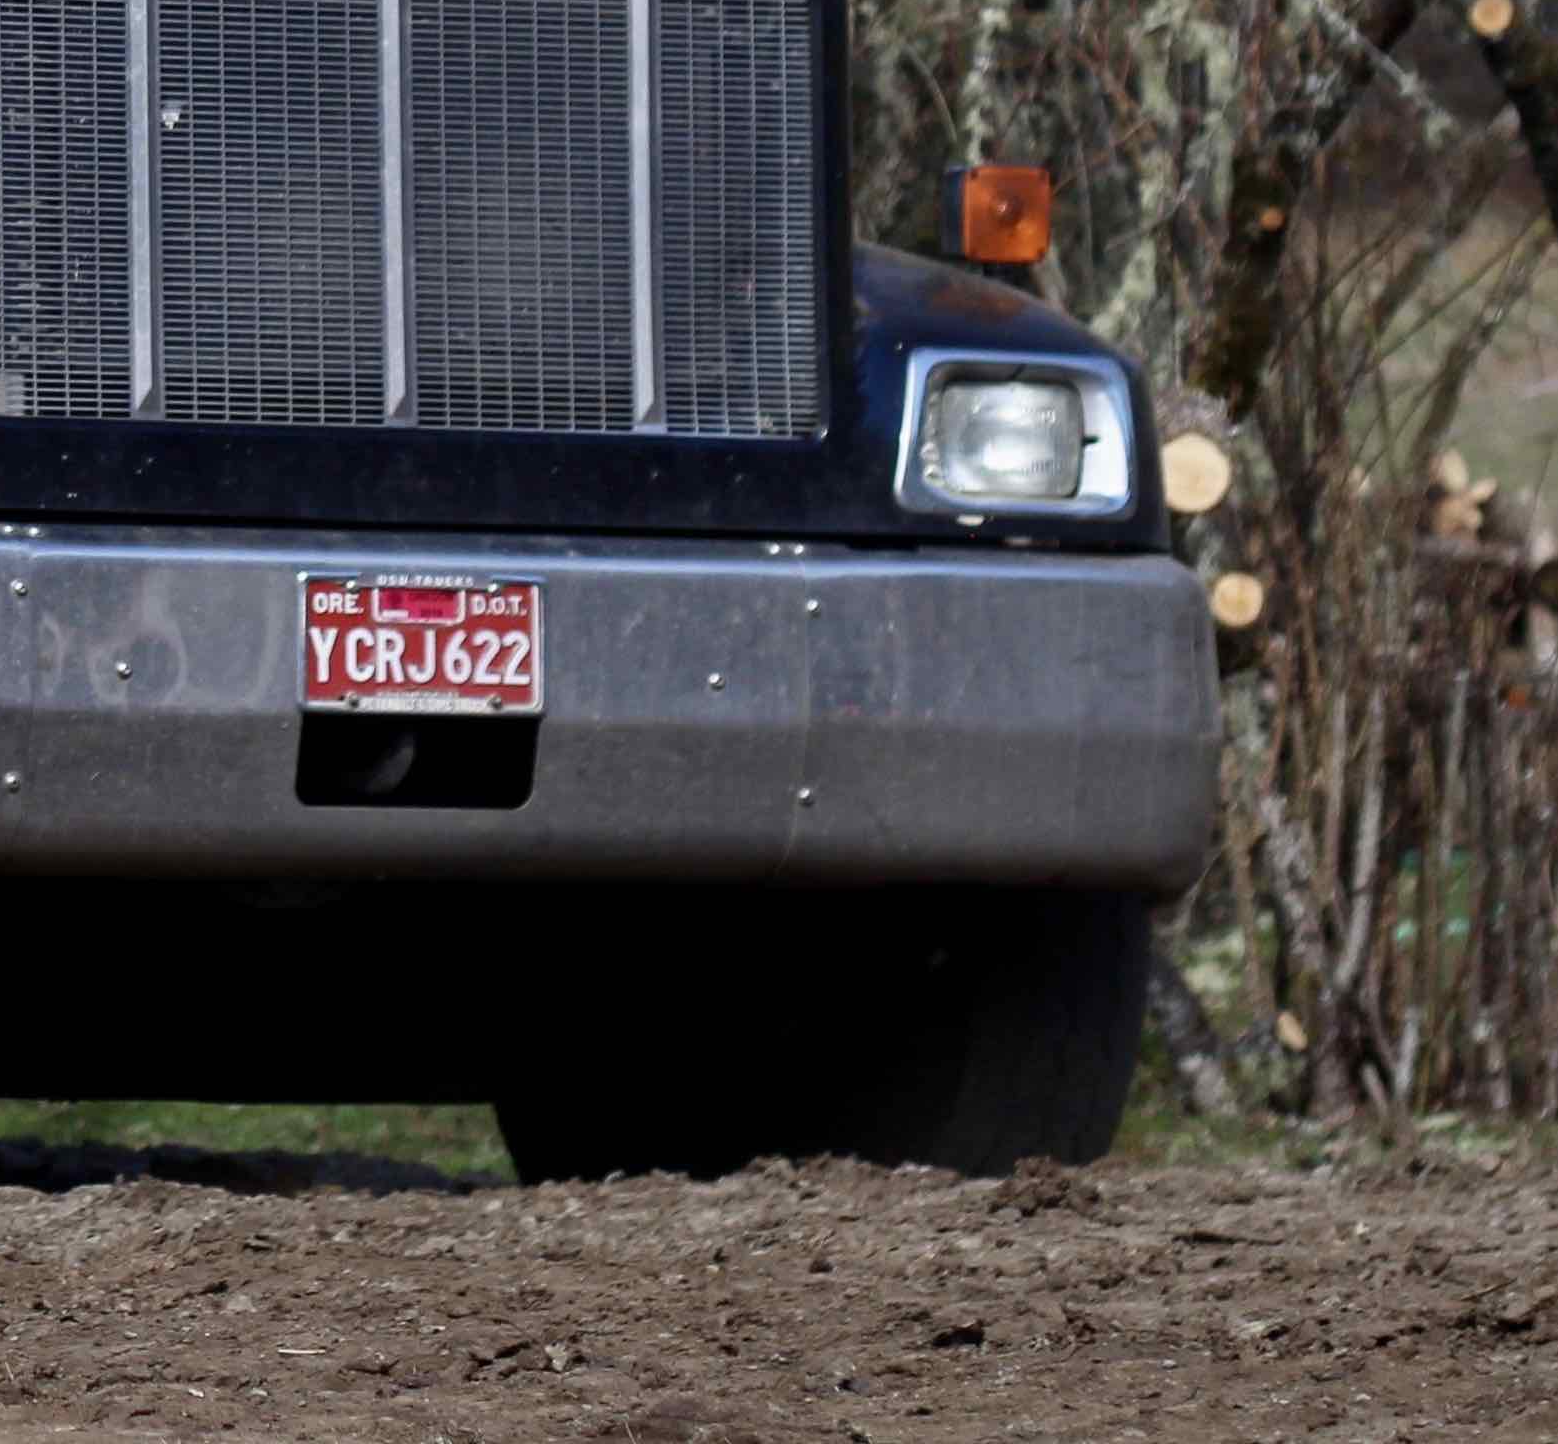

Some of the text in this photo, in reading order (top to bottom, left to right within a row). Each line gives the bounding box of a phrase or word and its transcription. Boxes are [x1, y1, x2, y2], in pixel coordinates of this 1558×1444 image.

[311, 592, 364, 615] ORE.
[470, 595, 528, 617] D.O.T.
[308, 626, 532, 686] YCRJ622
